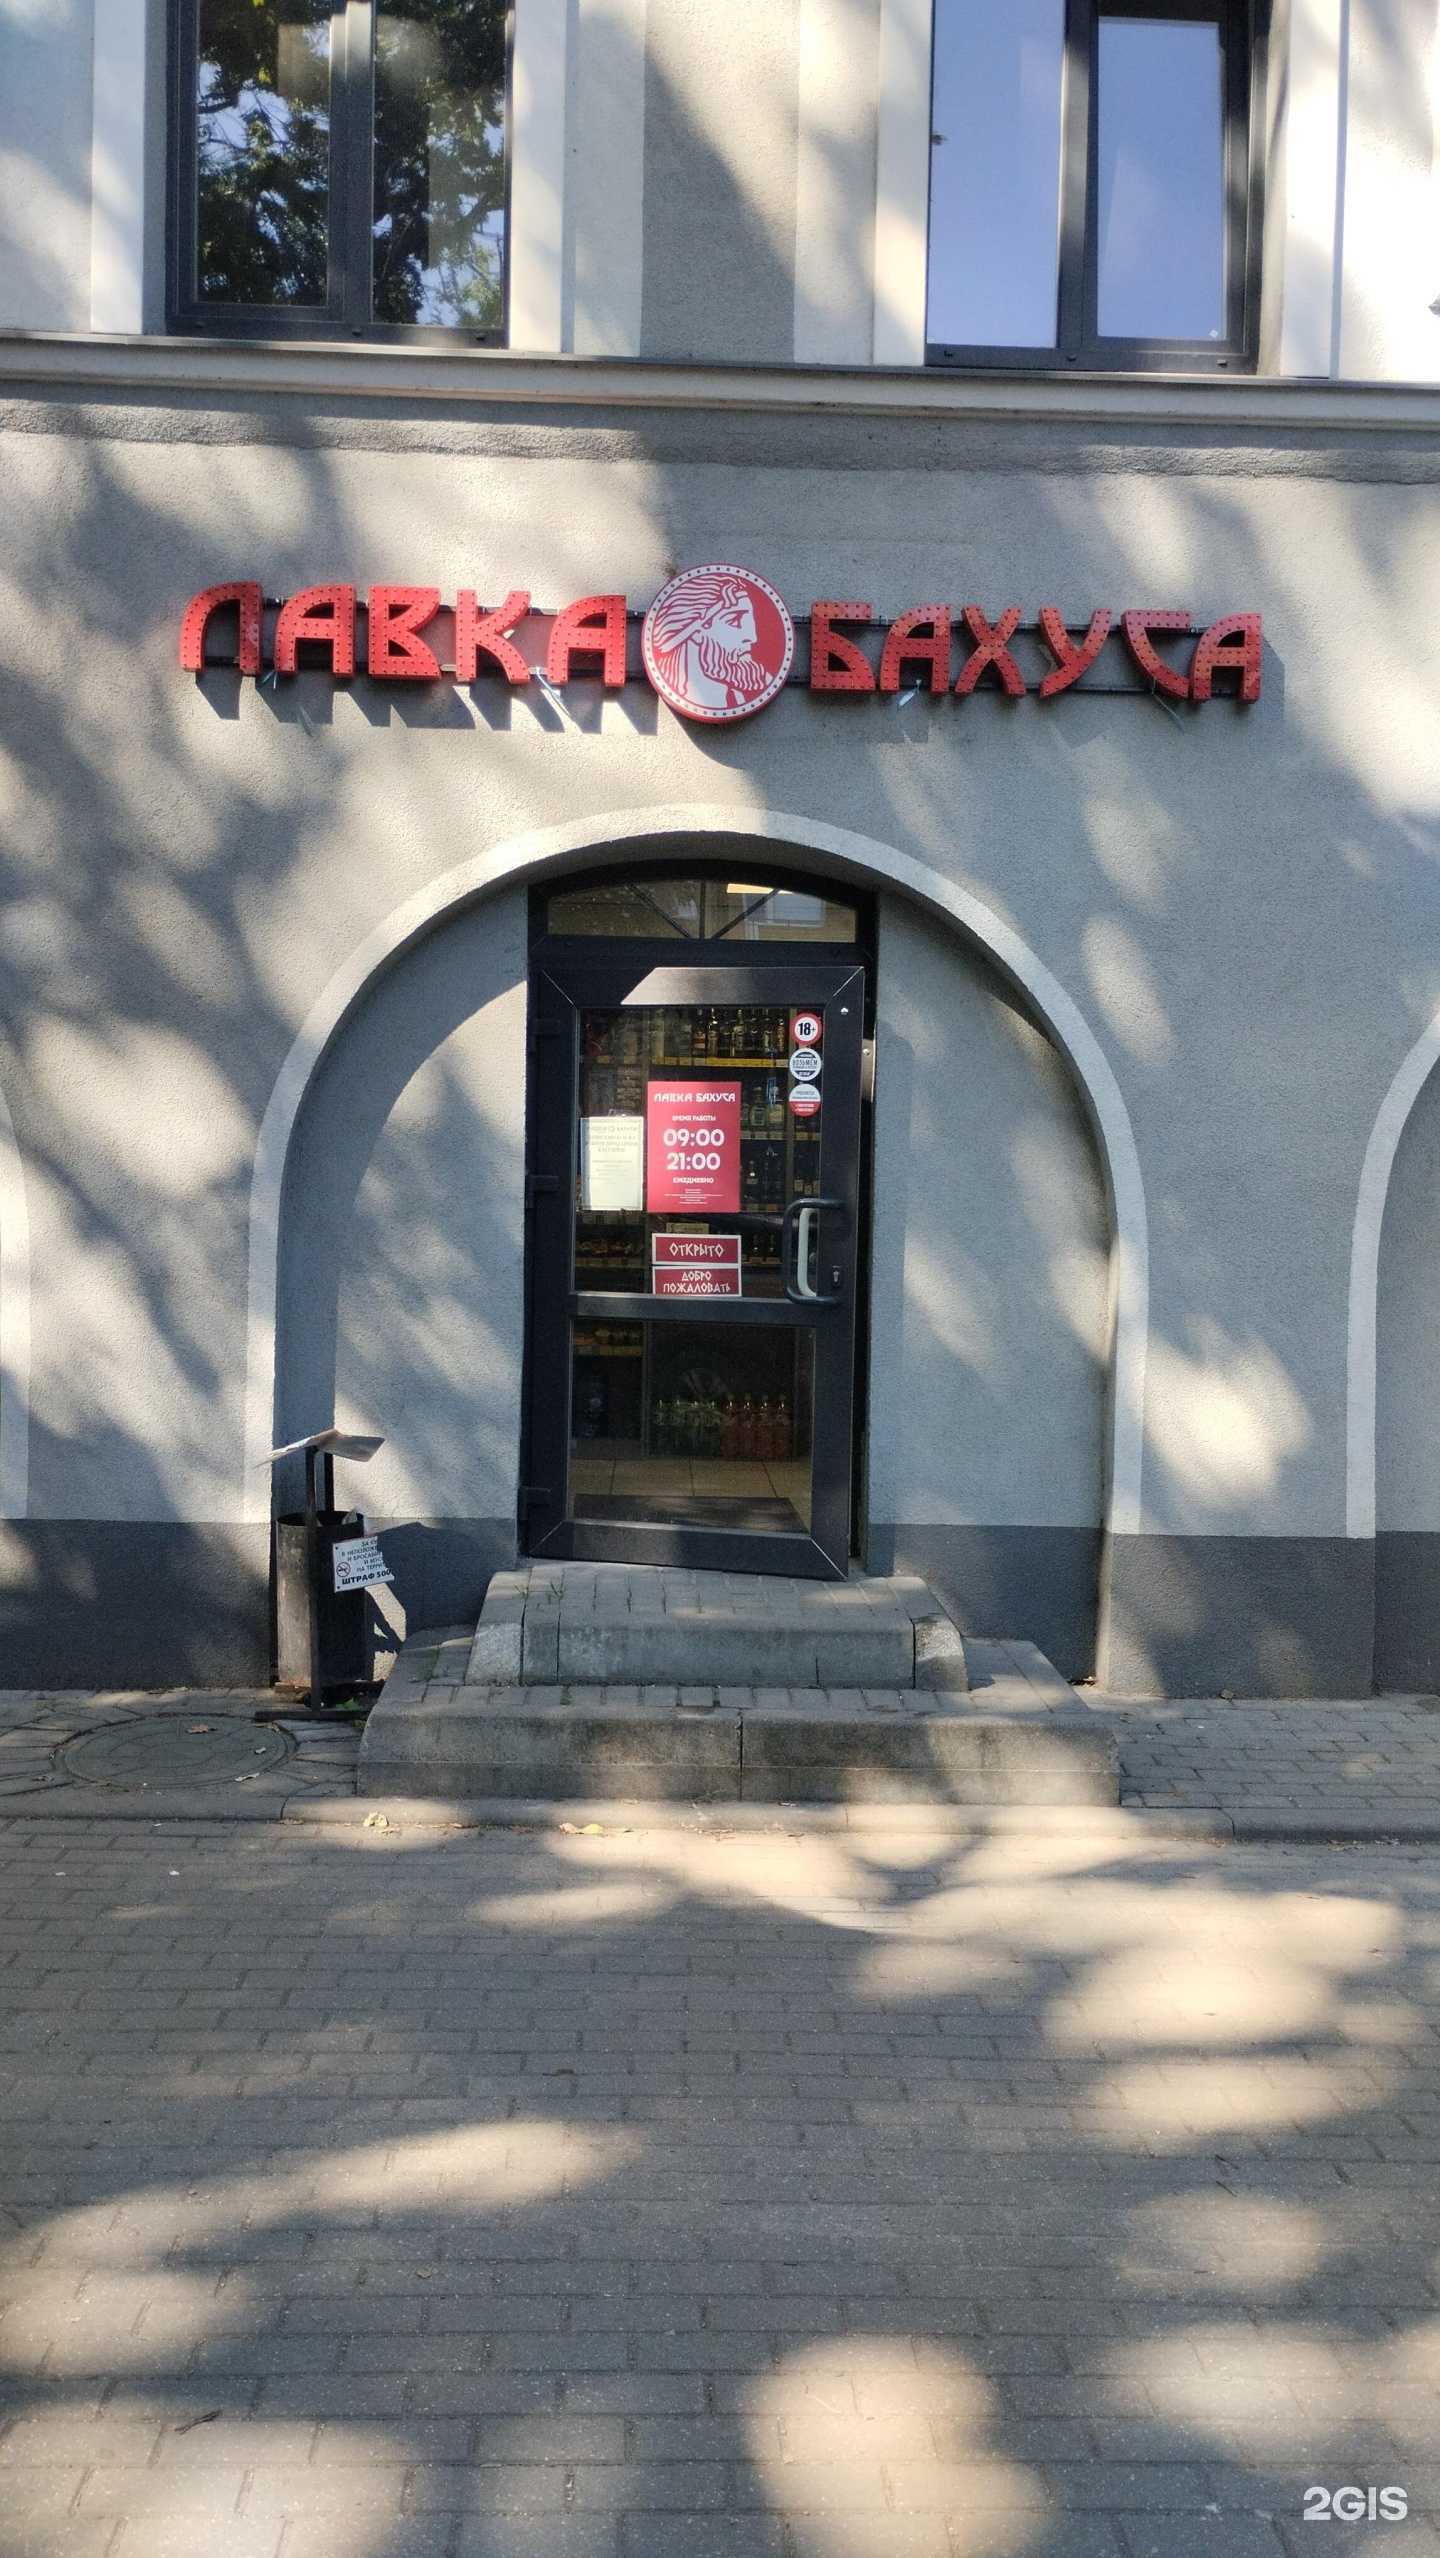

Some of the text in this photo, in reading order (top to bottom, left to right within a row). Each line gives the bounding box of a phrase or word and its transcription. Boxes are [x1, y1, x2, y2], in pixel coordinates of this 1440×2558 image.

[180, 581, 1262, 704] ЛАВКА БАХУСА
[798, 1022, 816, 1036] 18+
[654, 1092, 736, 1102] ЛАВКА БАХУСА
[663, 1128, 724, 1147] 09:00
[666, 1152, 721, 1170] 21:00
[669, 1242, 724, 1257] ОТКРЫТО
[681, 1270, 712, 1281] ДОБРО
[663, 1282, 731, 1293] ПОЖАЛОВАТЬ
[342, 1573, 375, 1584] ШТРАФ
